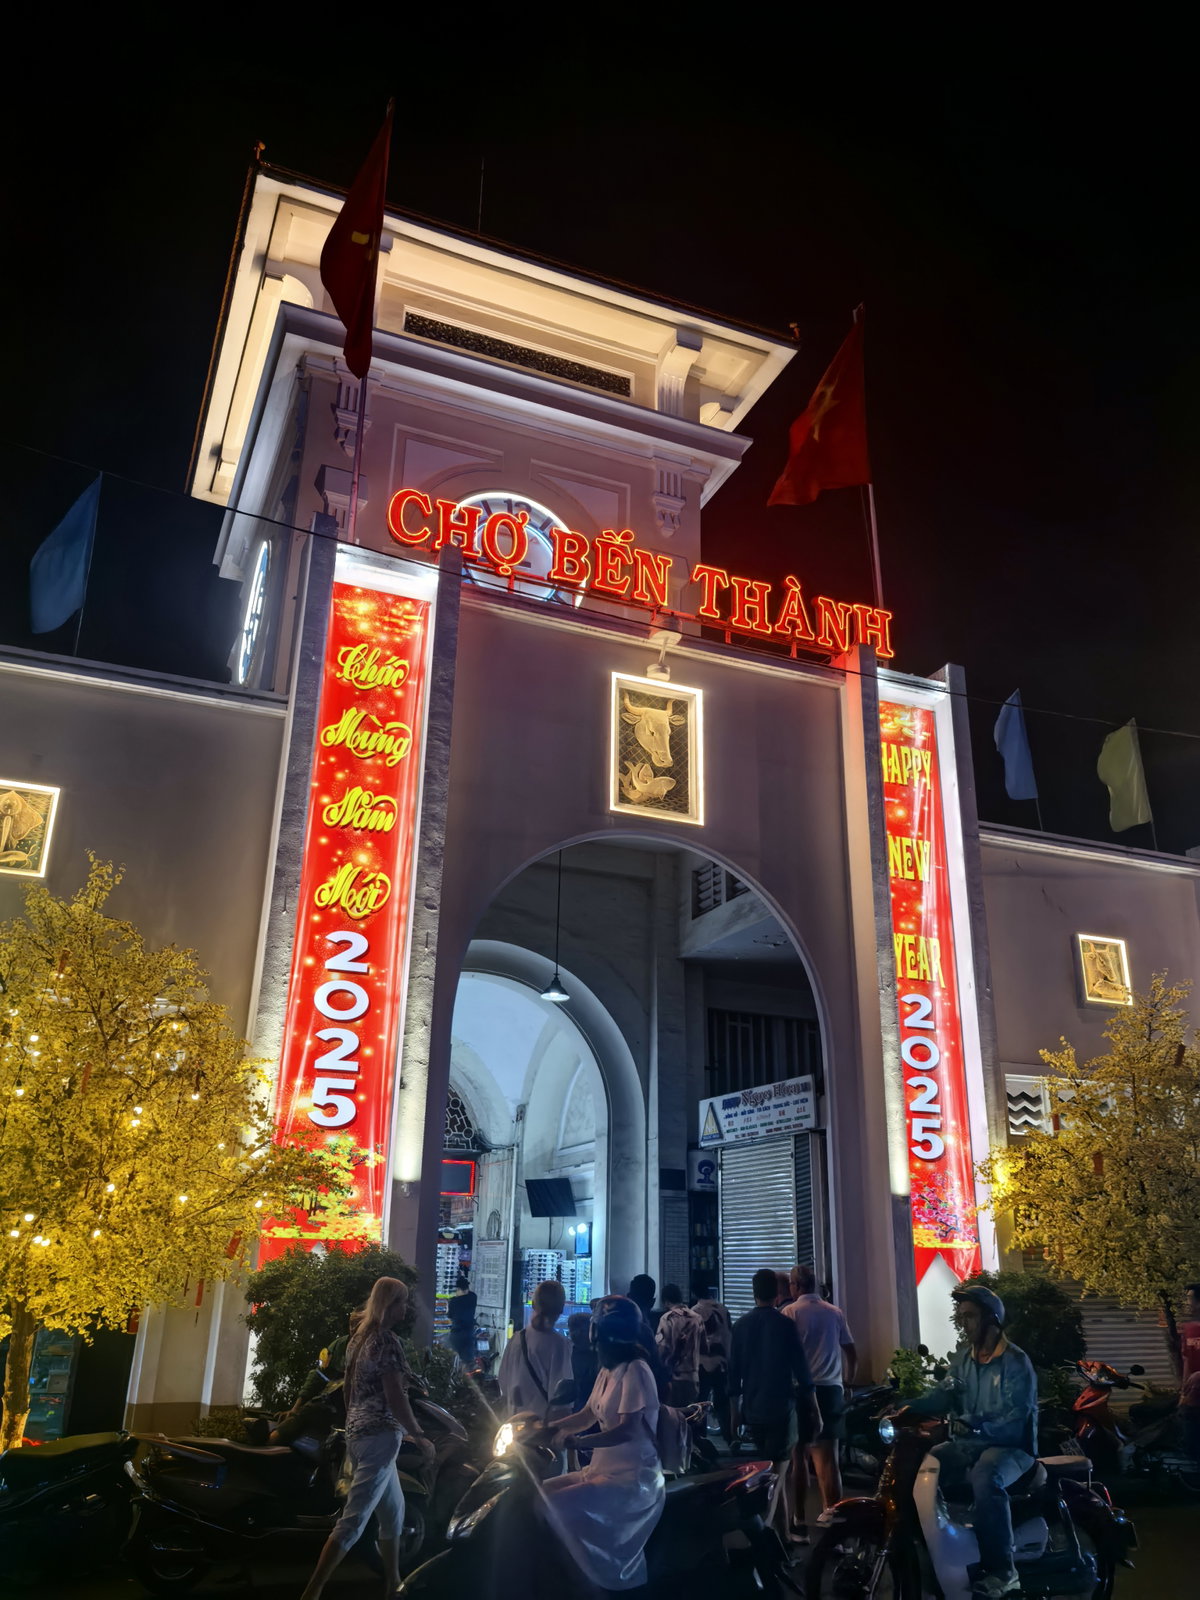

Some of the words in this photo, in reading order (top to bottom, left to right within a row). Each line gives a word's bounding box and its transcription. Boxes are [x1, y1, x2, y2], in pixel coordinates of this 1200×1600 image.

[387, 487, 530, 576] CHỢ
[550, 529, 673, 606] BẾN
[691, 564, 895, 657] THÀNH
[336, 643, 410, 690] Chúc
[320, 706, 413, 767] Mừng
[322, 786, 398, 832] Năm
[888, 834, 931, 882] NEW
[314, 862, 391, 917] Mới
[893, 932, 946, 988] YEAR
[307, 930, 370, 1128] 2025
[901, 993, 944, 1160] 2025
